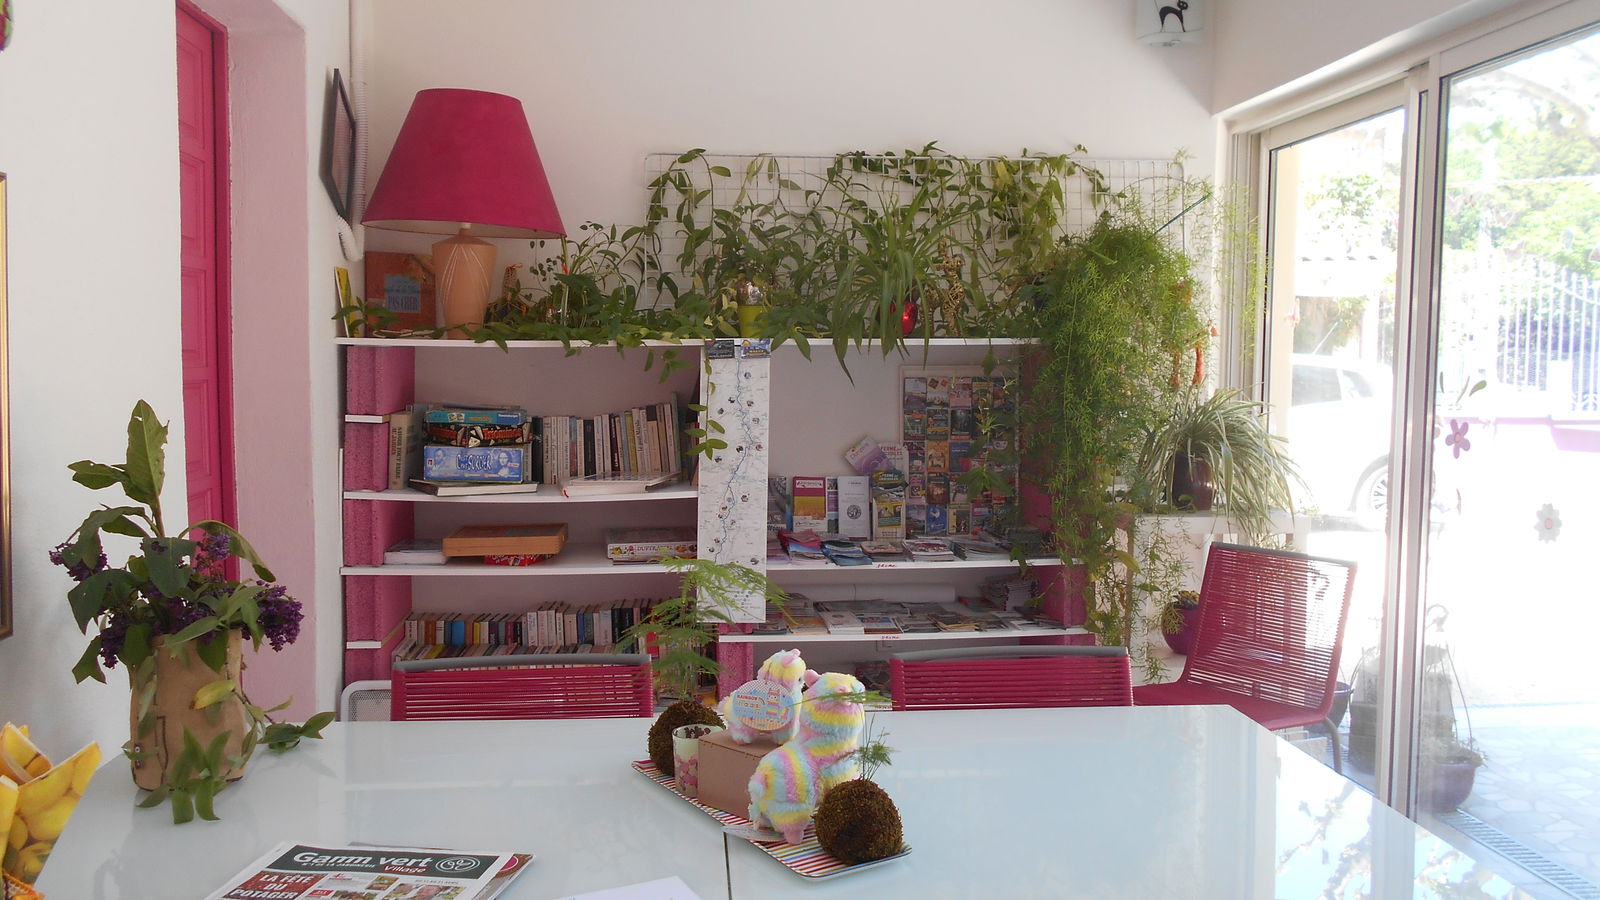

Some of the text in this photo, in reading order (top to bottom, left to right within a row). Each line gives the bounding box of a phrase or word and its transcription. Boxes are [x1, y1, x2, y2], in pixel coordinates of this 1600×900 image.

[293, 852, 433, 867] Gamm vert
[384, 865, 427, 873] Village
[259, 874, 314, 884] LA FÊTE
[229, 889, 299, 899] POTAGER
